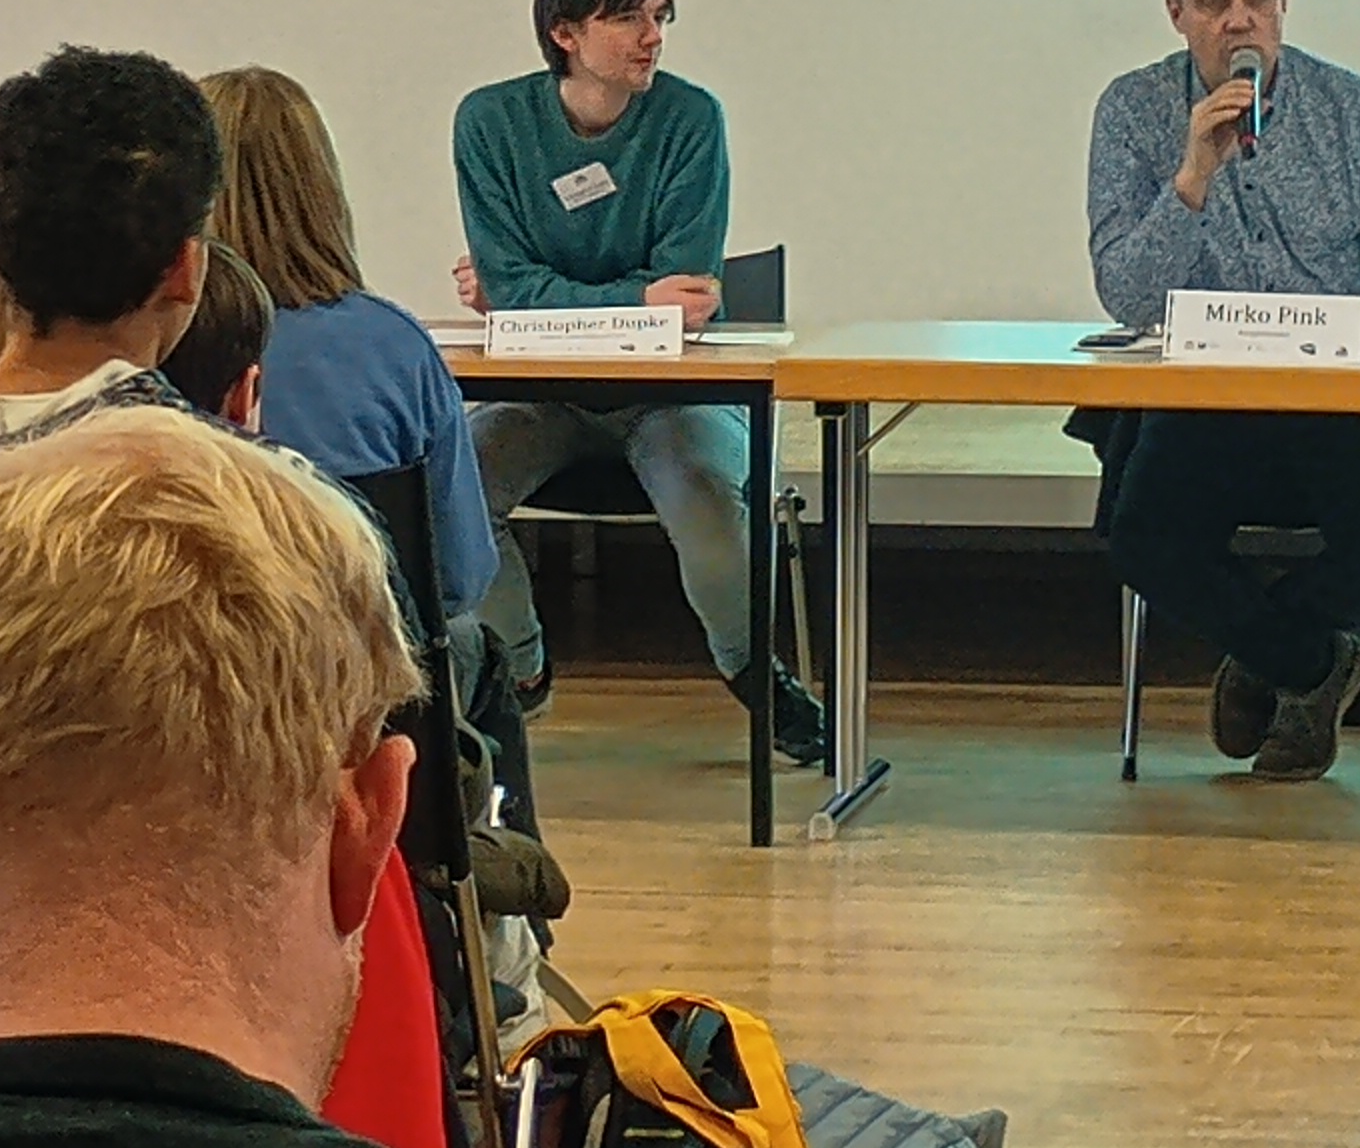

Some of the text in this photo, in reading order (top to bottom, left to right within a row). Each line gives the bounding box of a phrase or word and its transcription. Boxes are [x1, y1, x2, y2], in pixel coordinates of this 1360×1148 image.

[1205, 303, 1328, 326] Mirko Pink
[499, 317, 607, 335] Christopher
